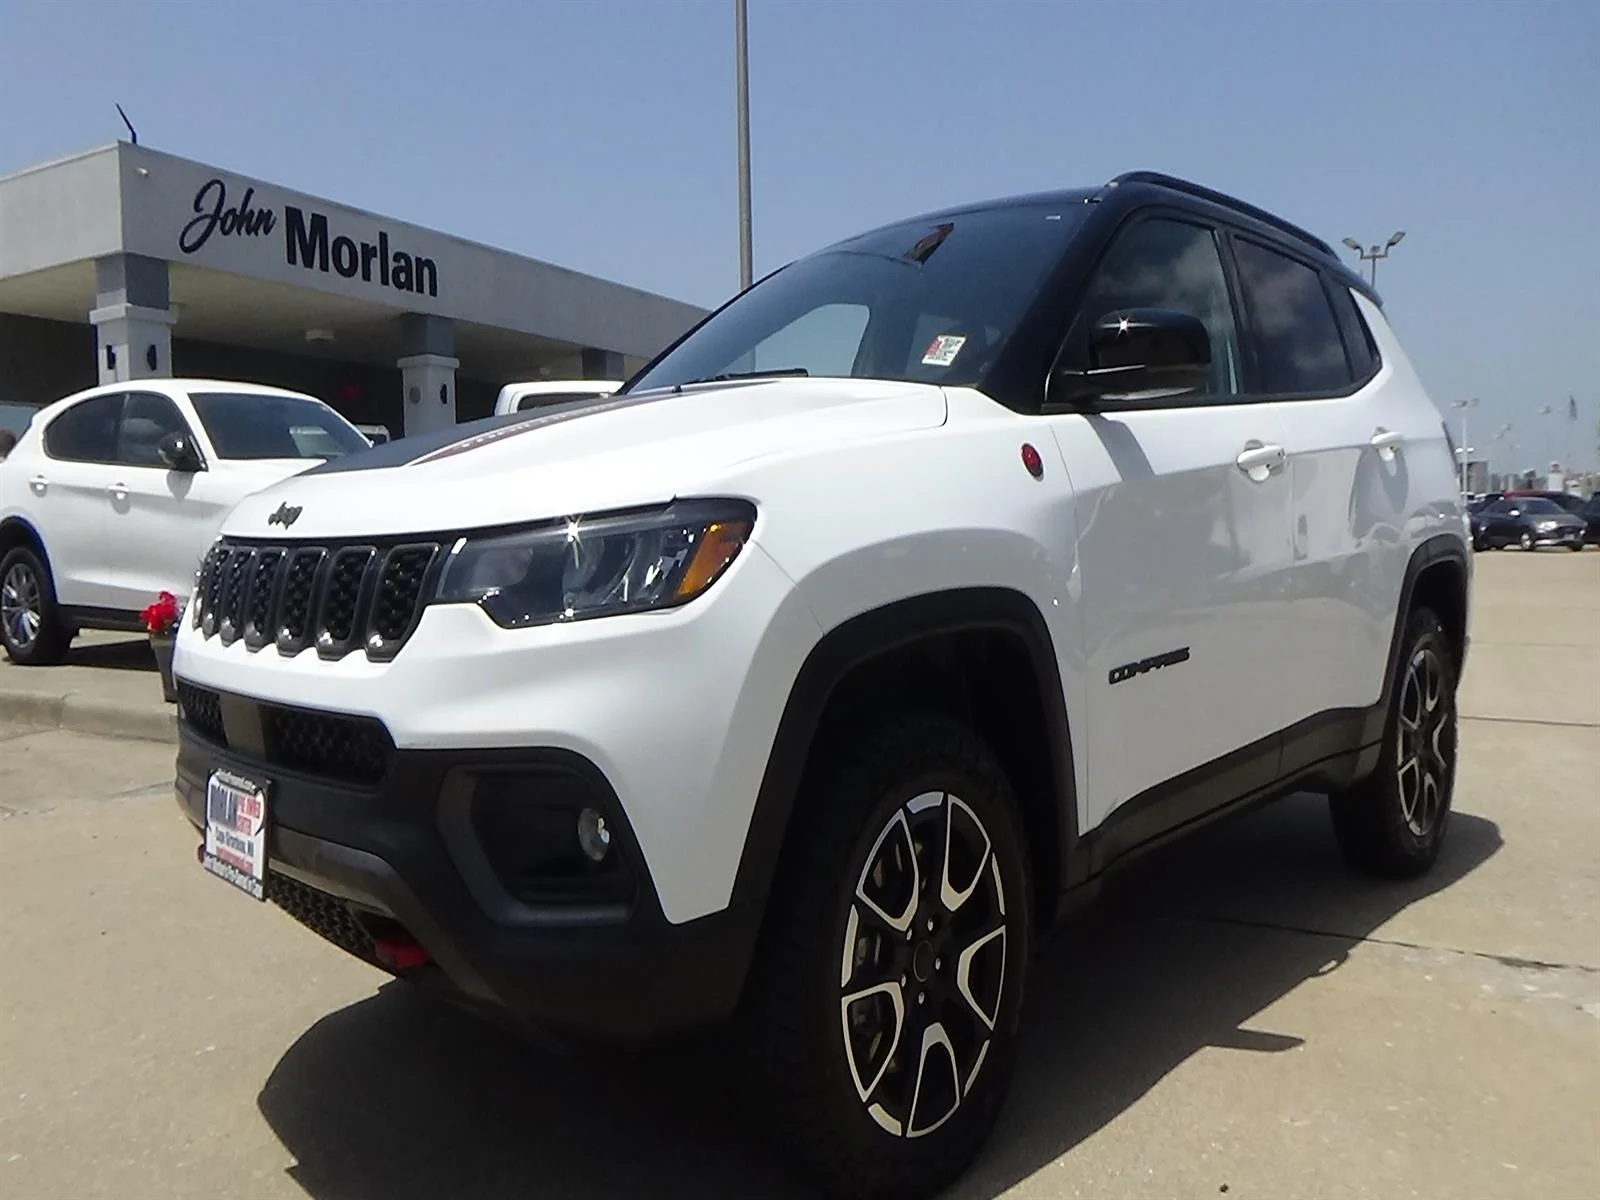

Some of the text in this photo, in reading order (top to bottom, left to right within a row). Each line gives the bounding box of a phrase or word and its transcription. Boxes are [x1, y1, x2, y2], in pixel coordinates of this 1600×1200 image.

[179, 180, 438, 297] John Morlan
[1109, 647, 1190, 685] COMPASS
